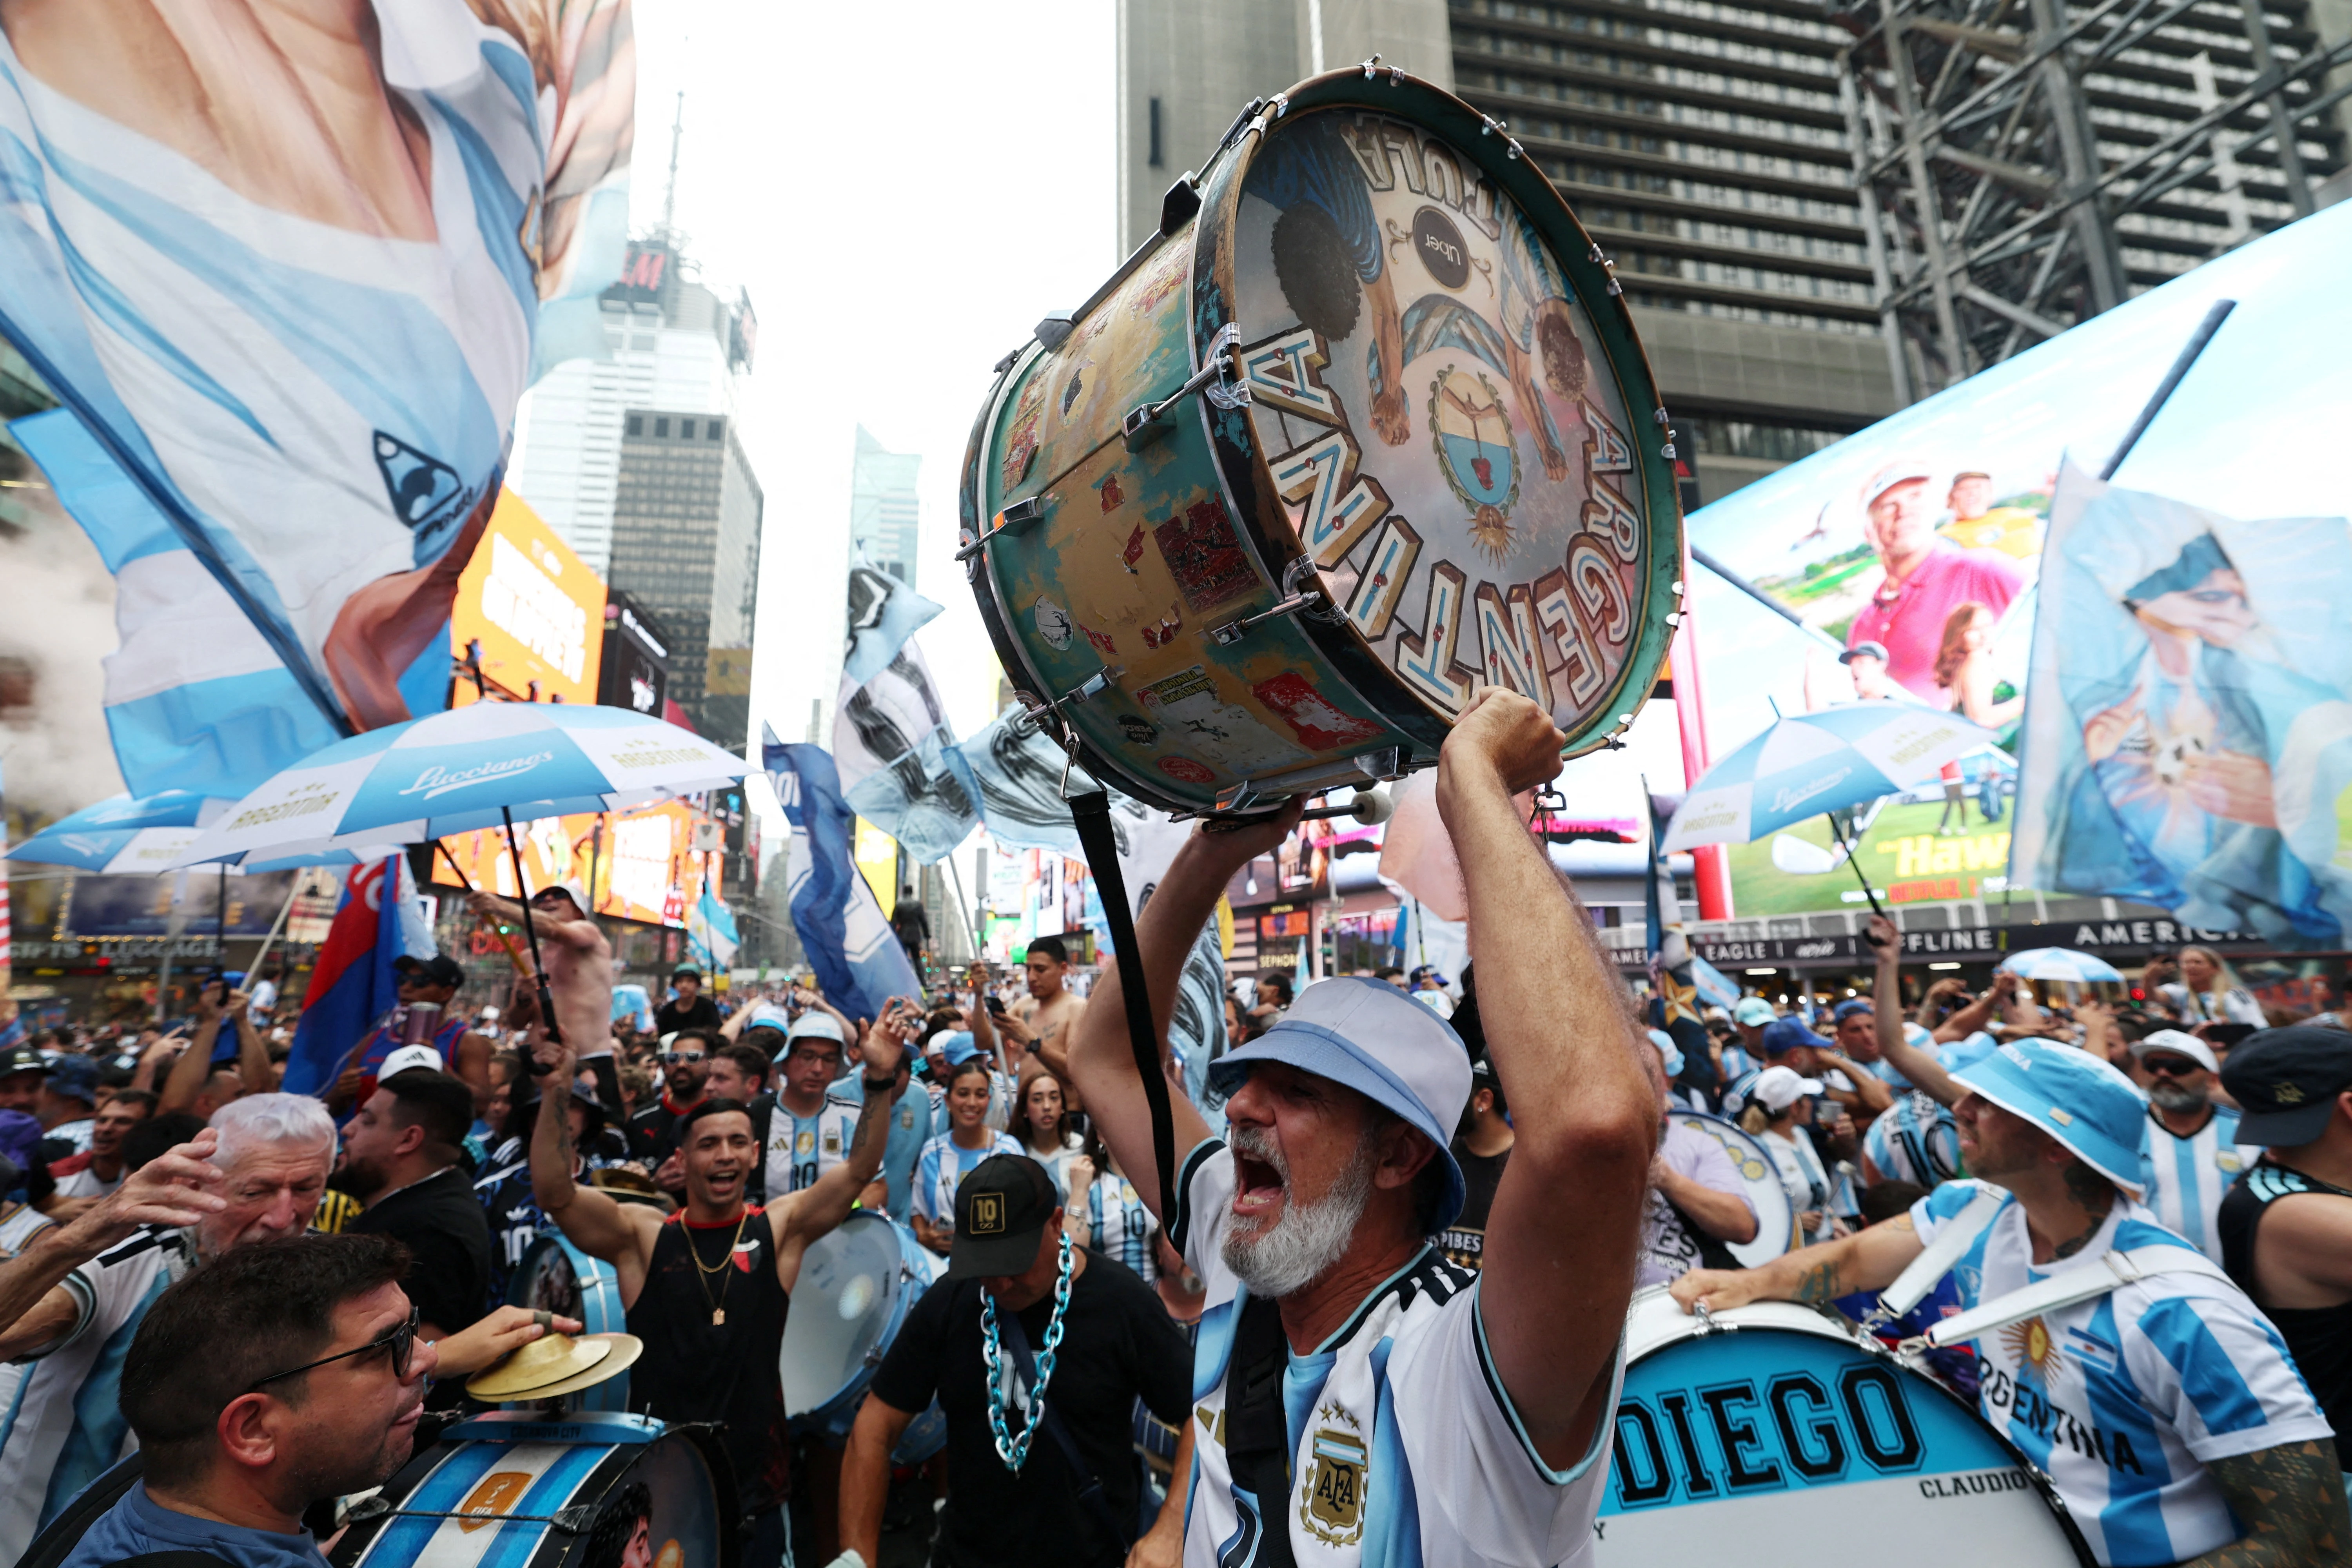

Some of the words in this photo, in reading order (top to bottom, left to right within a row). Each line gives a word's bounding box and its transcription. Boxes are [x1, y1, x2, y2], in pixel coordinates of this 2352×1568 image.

[1425, 234, 1461, 265] uber
[1240, 327, 1639, 721] ARGENTINA
[398, 750, 554, 799] Lucciano's
[1896, 832, 2011, 877] Haw
[1888, 878, 1962, 904] NETFLIX
[1901, 929, 1993, 952] FLINE
[2075, 922, 2259, 944] AMERIC
[1259, 953, 1300, 968] SEPHOR
[1705, 943, 1766, 961] EAGLE
[975, 1200, 997, 1222] 10
[1120, 1208, 1146, 1238] 10
[1440, 1231, 1481, 1253] PIBES
[1655, 1254, 1690, 1275] WORL
[1980, 1357, 2144, 1475] RGENTINA
[561, 1426, 582, 1439] CITY
[1610, 1362, 1926, 1511] DIEGO
[471, 1506, 493, 1515] FIFA
